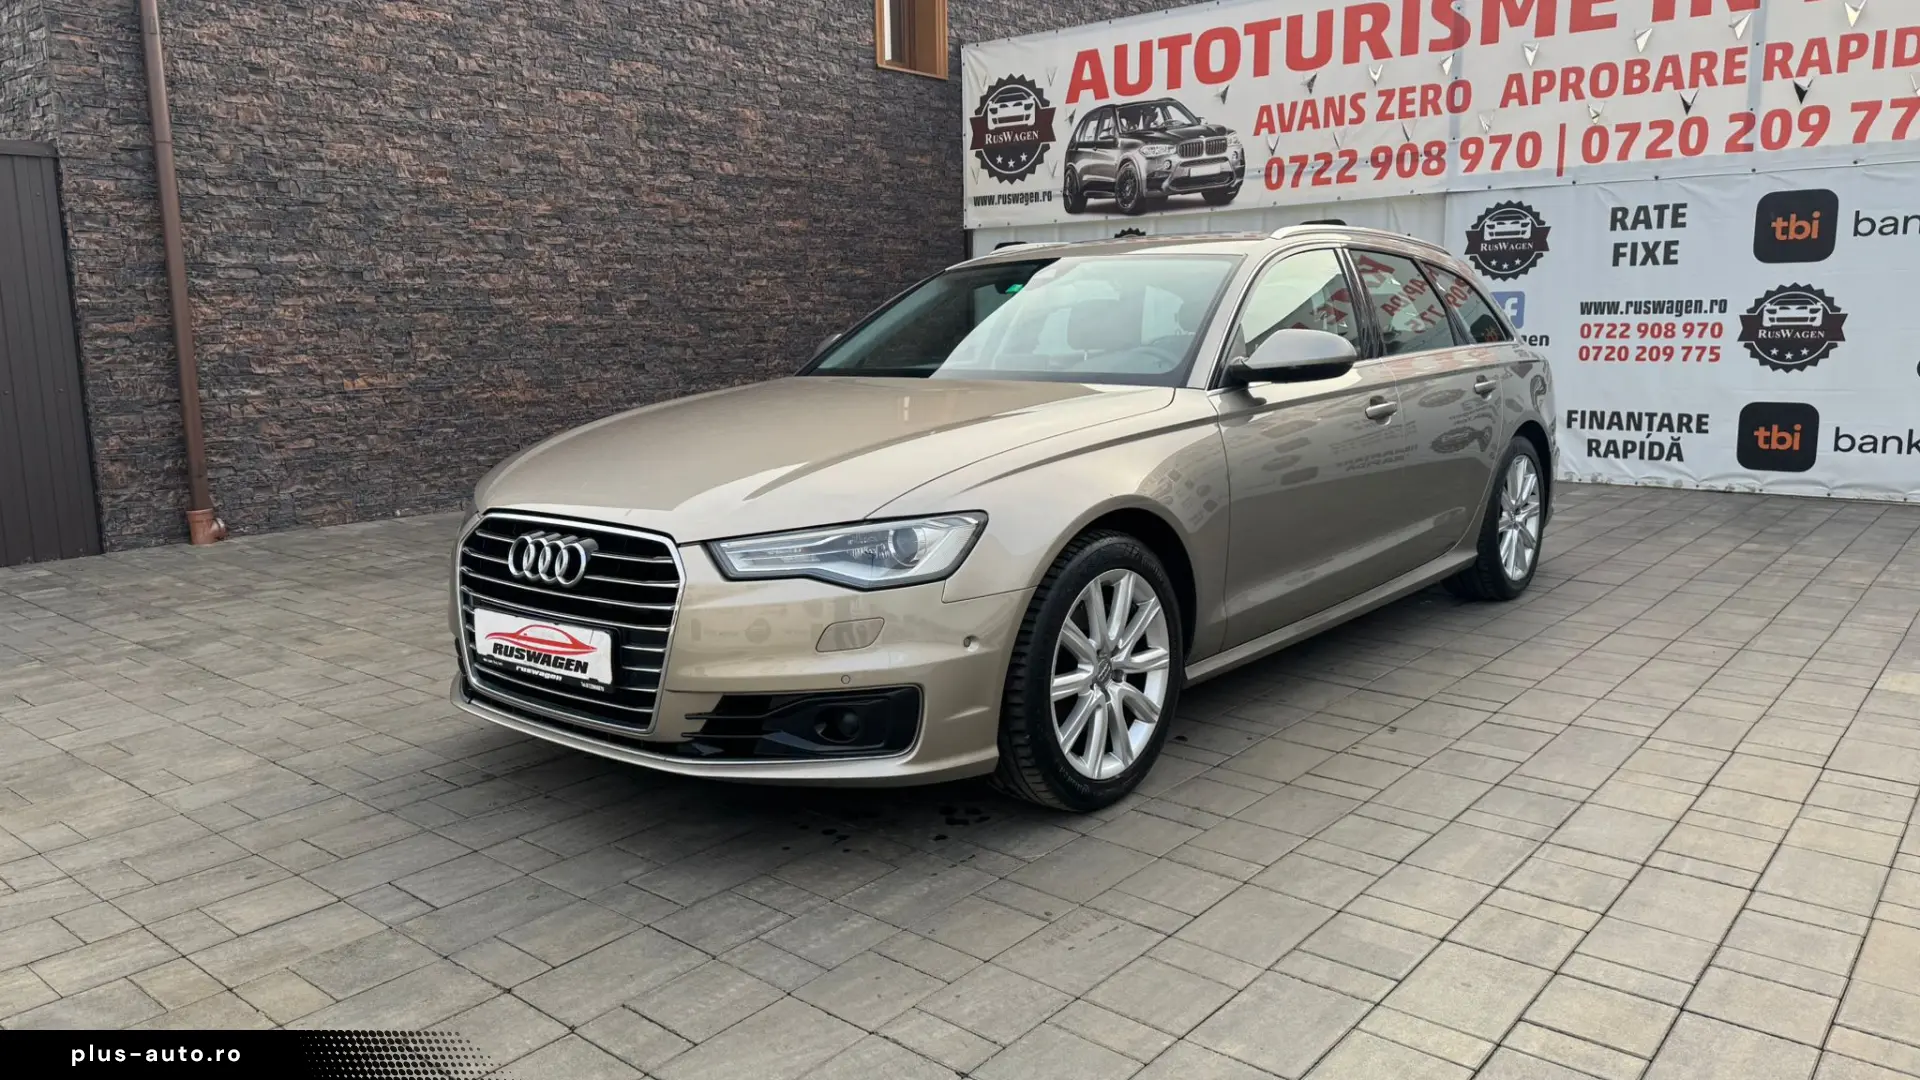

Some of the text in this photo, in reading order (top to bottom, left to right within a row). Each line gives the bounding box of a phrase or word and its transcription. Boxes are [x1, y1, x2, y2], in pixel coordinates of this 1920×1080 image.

[1253, 92, 1366, 136] AVANS
[1375, 80, 1472, 122] ZERO
[1500, 46, 1748, 108] APROBARE
[1264, 149, 1358, 190] 0722
[1370, 140, 1446, 181] 908
[1459, 131, 1542, 173] 970
[1581, 115, 1709, 164] 0720
[1724, 104, 1831, 153] 209
[973, 190, 1053, 206] www.ruswagen.ro
[1610, 203, 1688, 231] RATE
[1771, 210, 1920, 241] tbi ban
[1612, 240, 1680, 267] FIXE
[1580, 299, 1728, 318] www.ruswagen.ro
[1580, 321, 1724, 339] 0722 908 970
[1578, 345, 1721, 362] 0720 209 775
[1754, 424, 1920, 454] tbi bank
[492, 642, 589, 675] RUSWAGEN
[515, 665, 562, 681] ruswagen
